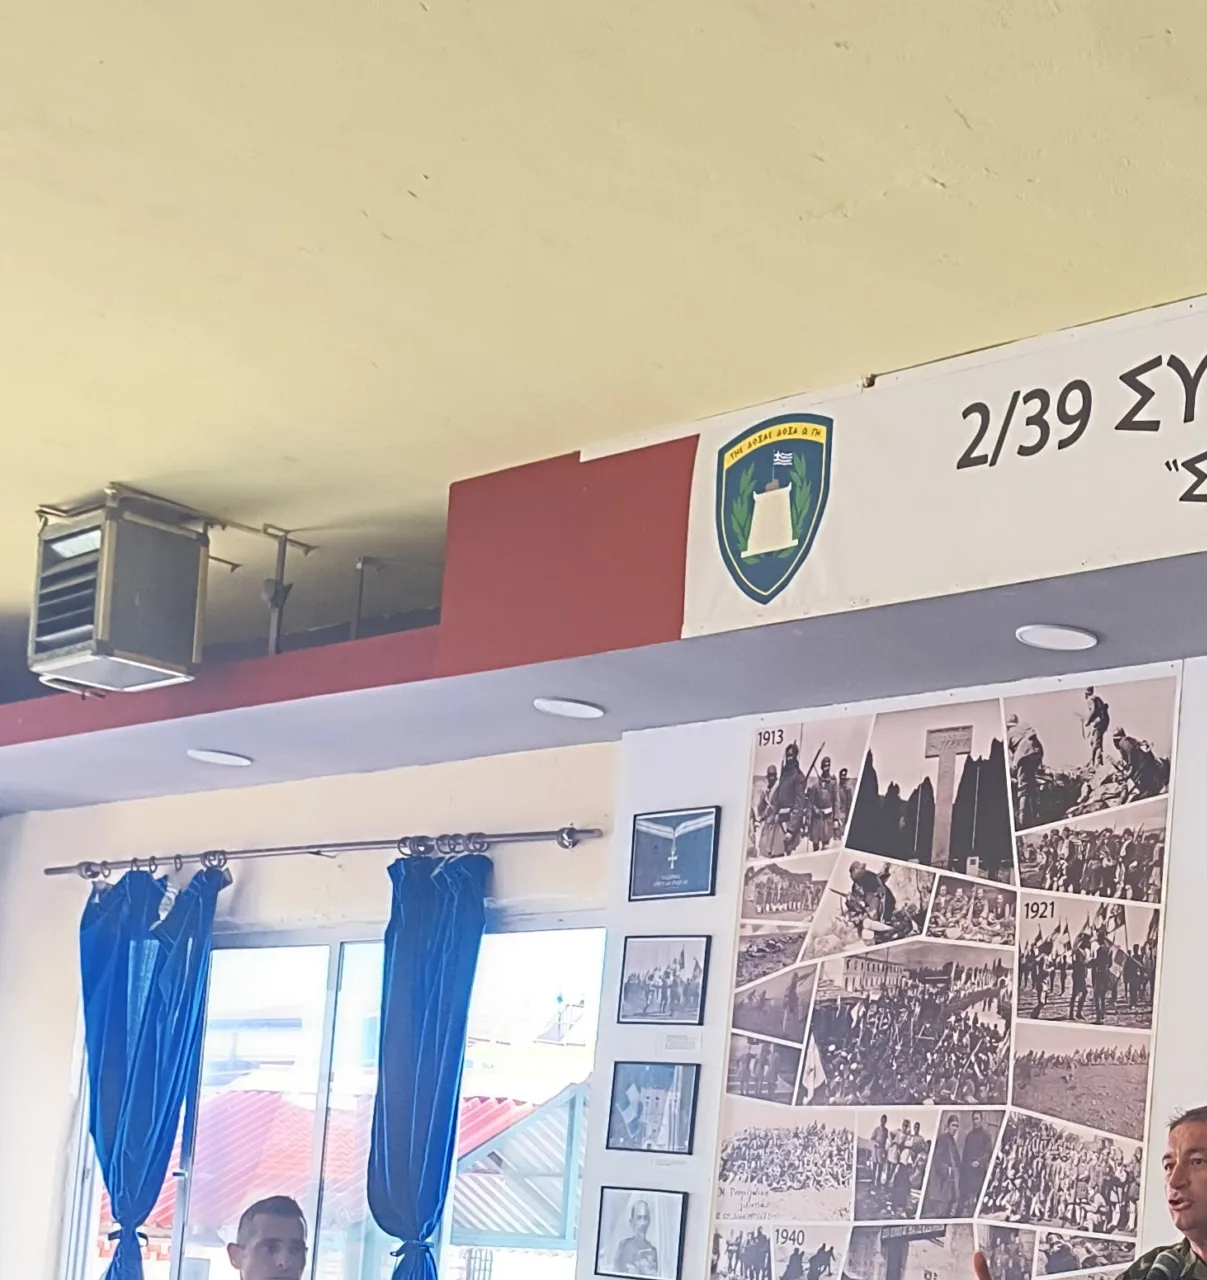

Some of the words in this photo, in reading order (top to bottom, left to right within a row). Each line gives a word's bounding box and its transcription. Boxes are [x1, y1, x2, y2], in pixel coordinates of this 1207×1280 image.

[956, 379, 1092, 470] 2/39
[758, 729, 784, 746] 1913
[1024, 901, 1055, 919] 1921
[775, 1228, 805, 1245] 1940
